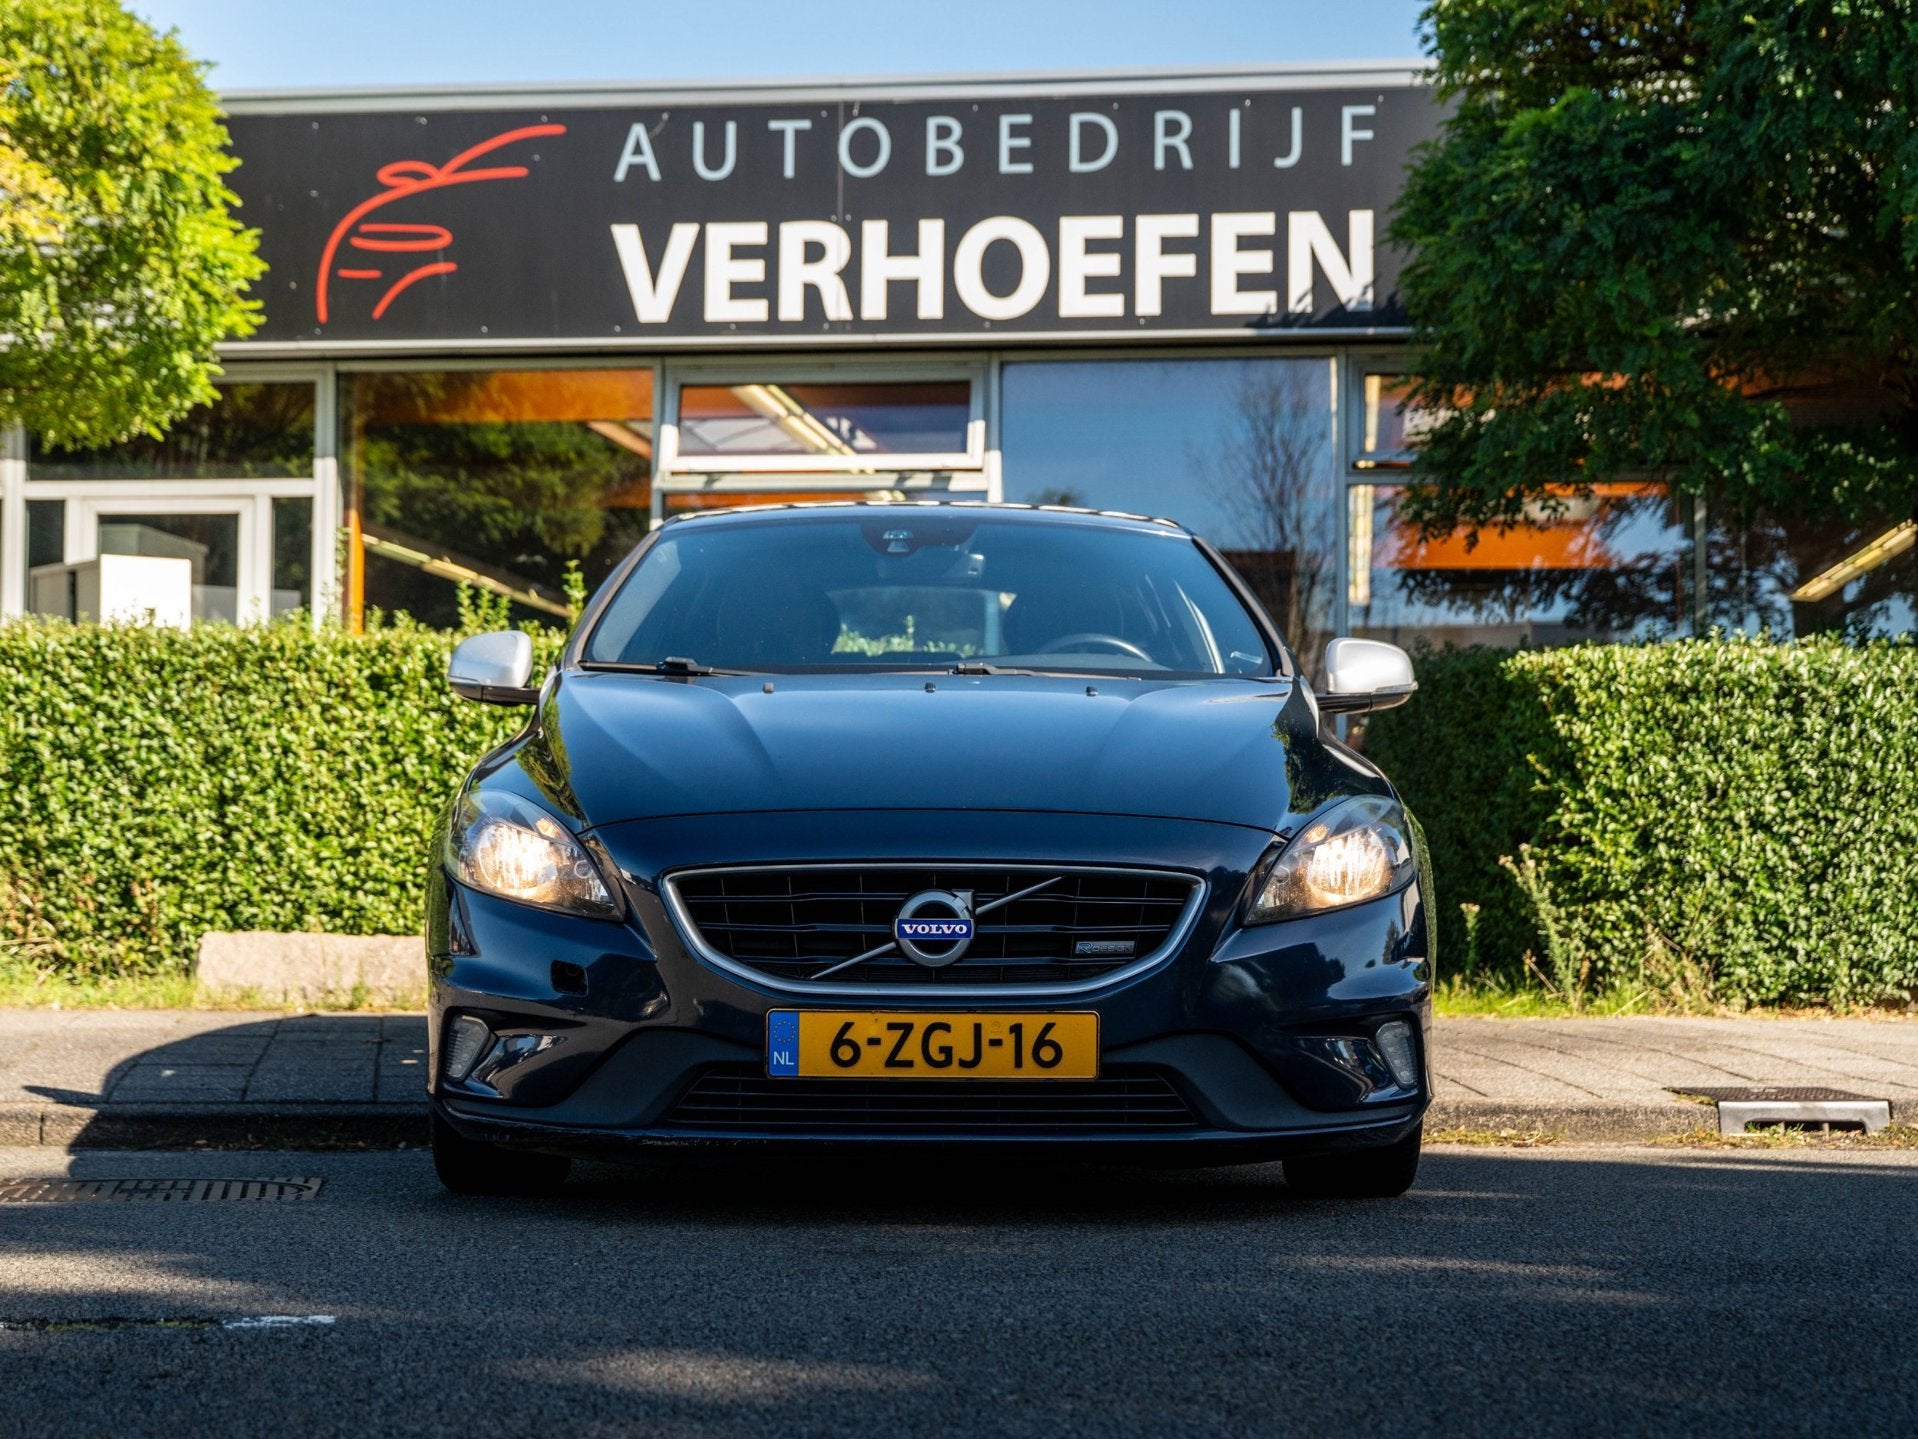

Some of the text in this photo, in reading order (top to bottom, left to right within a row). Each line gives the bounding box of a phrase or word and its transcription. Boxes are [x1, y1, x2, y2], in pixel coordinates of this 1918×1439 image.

[613, 105, 1376, 183] AUTOBEDRIJF
[610, 209, 1375, 324] VERHOEFEN
[901, 923, 968, 935] VOLVO
[773, 1051, 795, 1066] NL
[830, 1021, 1063, 1069] 6-ZGJ-16
